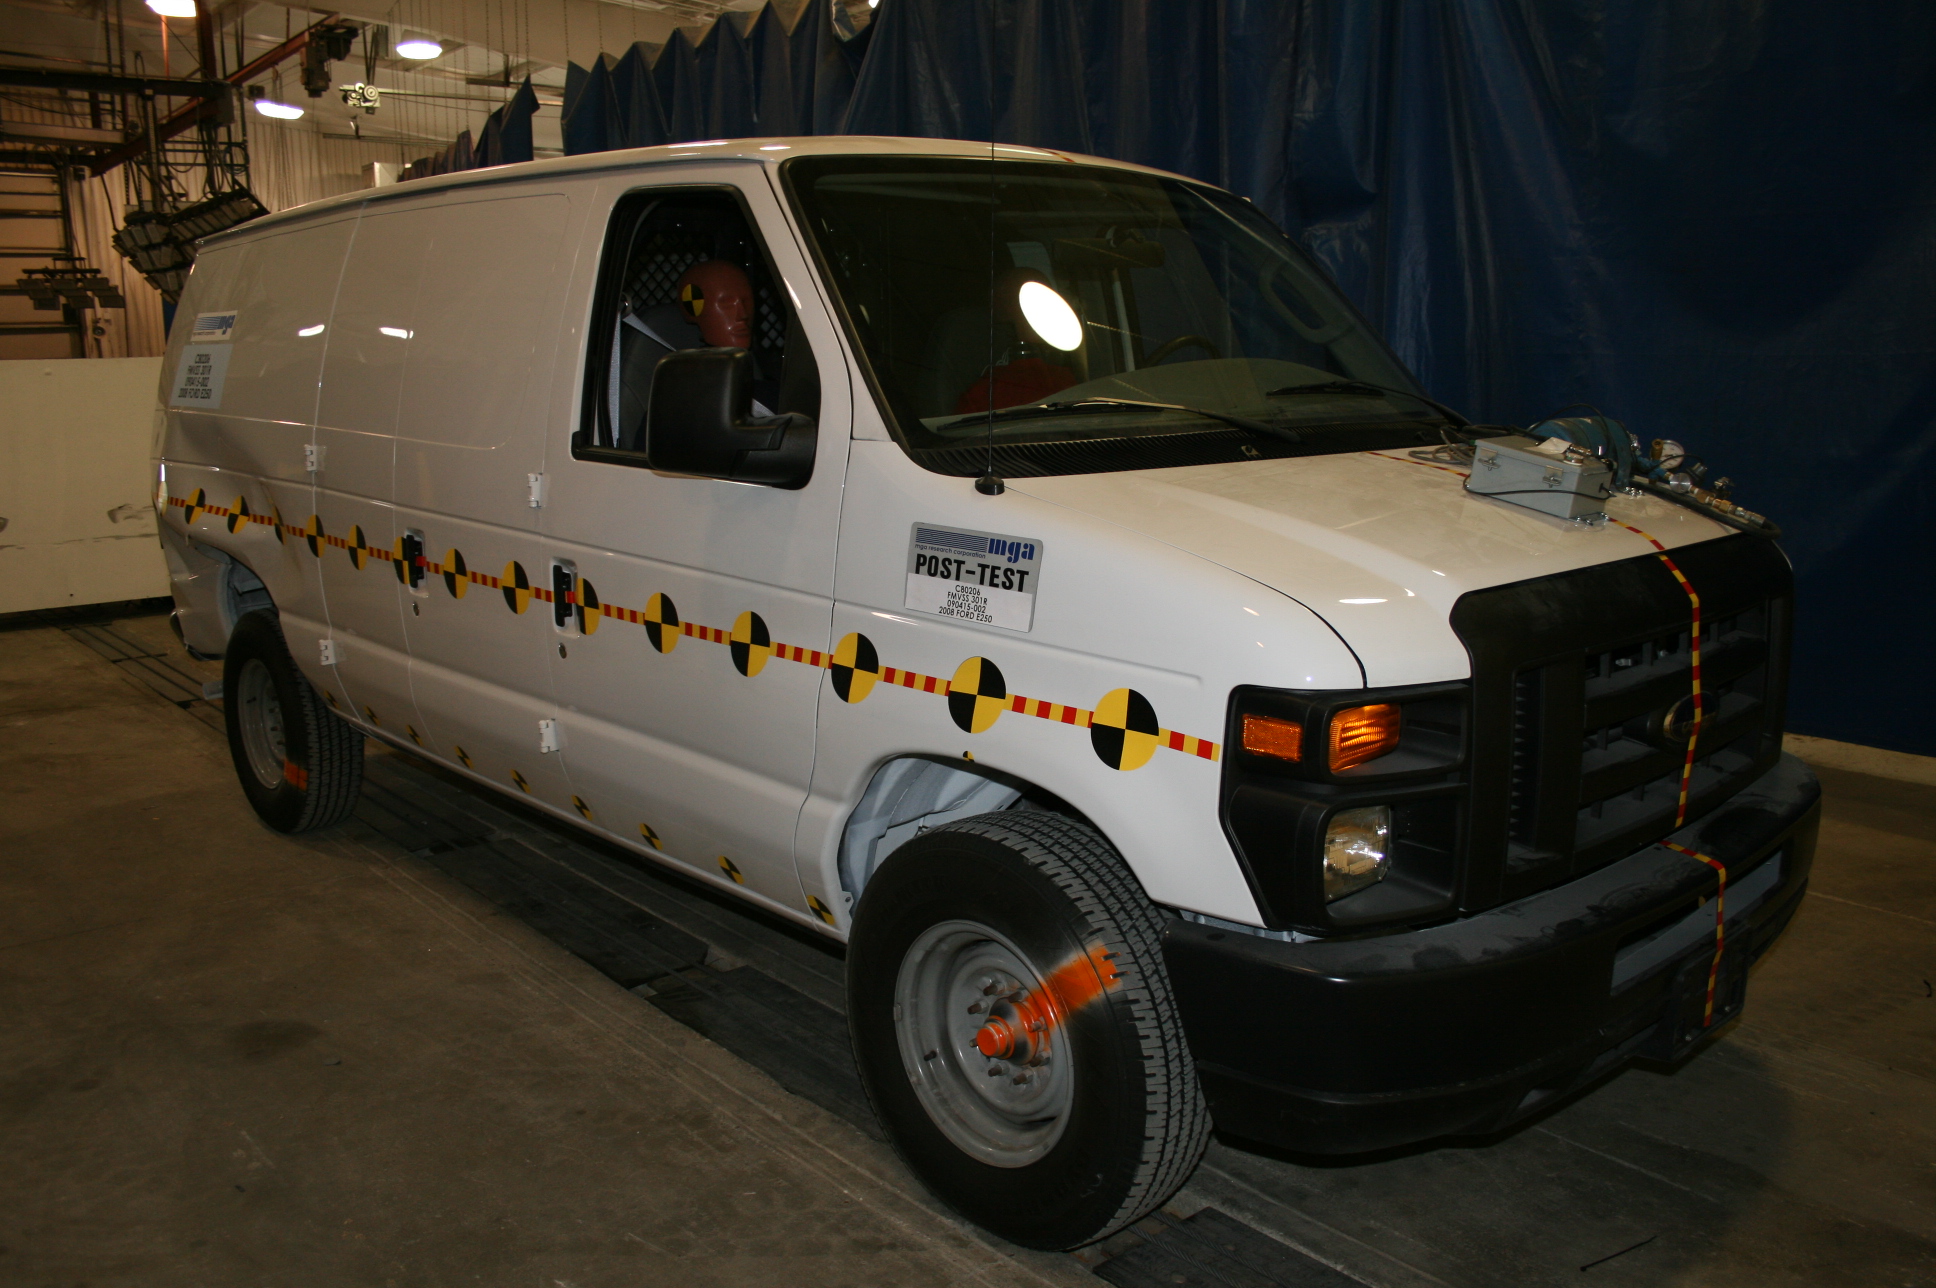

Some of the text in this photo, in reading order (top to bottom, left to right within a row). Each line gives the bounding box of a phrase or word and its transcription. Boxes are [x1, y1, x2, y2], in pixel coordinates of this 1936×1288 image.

[928, 545, 953, 553] research
[953, 549, 986, 559] corporation
[988, 538, 1035, 563] mga
[915, 553, 1029, 592] POST-TEST
[955, 584, 981, 596] C80206
[947, 591, 988, 606] FMVSS 301R
[946, 599, 987, 614] 090415-002
[938, 605, 993, 624] 2008 FORD E250
